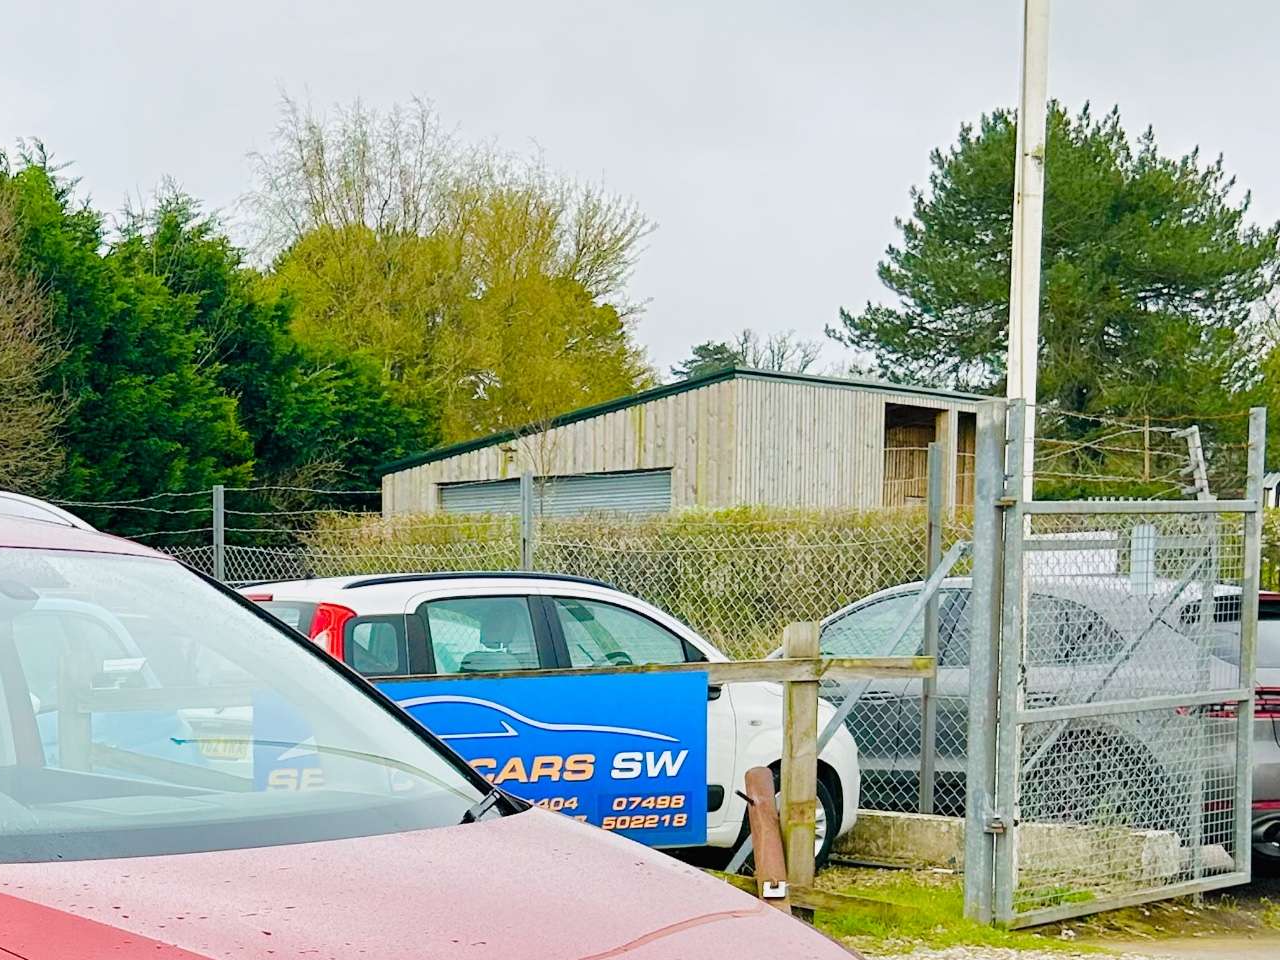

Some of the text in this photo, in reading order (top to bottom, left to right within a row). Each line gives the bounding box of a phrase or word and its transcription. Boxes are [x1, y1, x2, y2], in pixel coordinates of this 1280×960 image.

[468, 749, 689, 785] CARS SW
[529, 797, 578, 811] 404
[612, 794, 685, 810] 07498
[601, 814, 688, 831] 502218
